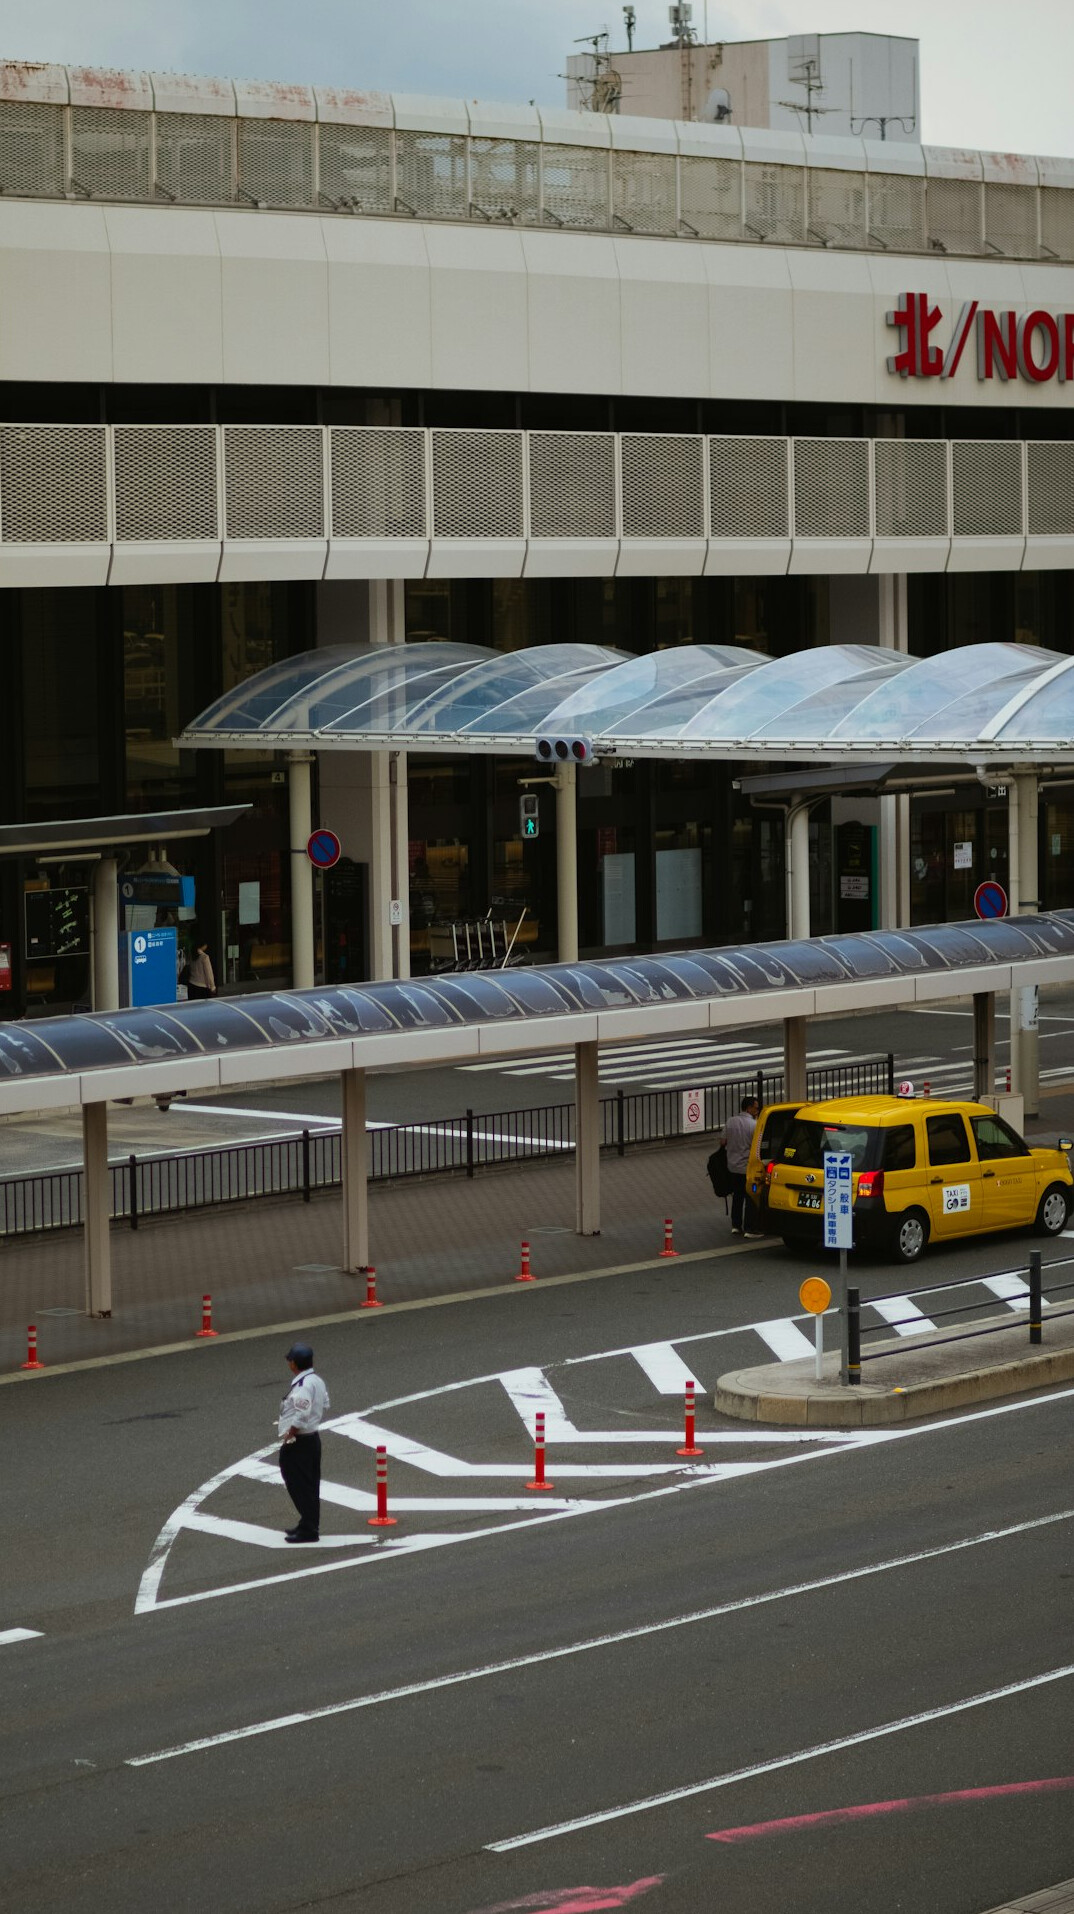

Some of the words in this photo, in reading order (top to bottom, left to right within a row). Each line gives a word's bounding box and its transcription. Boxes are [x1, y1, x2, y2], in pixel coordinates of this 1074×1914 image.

[839, 1184, 849, 1215] 一般車
[946, 1190, 958, 1198] TAXI
[946, 1198, 959, 1210] GO
